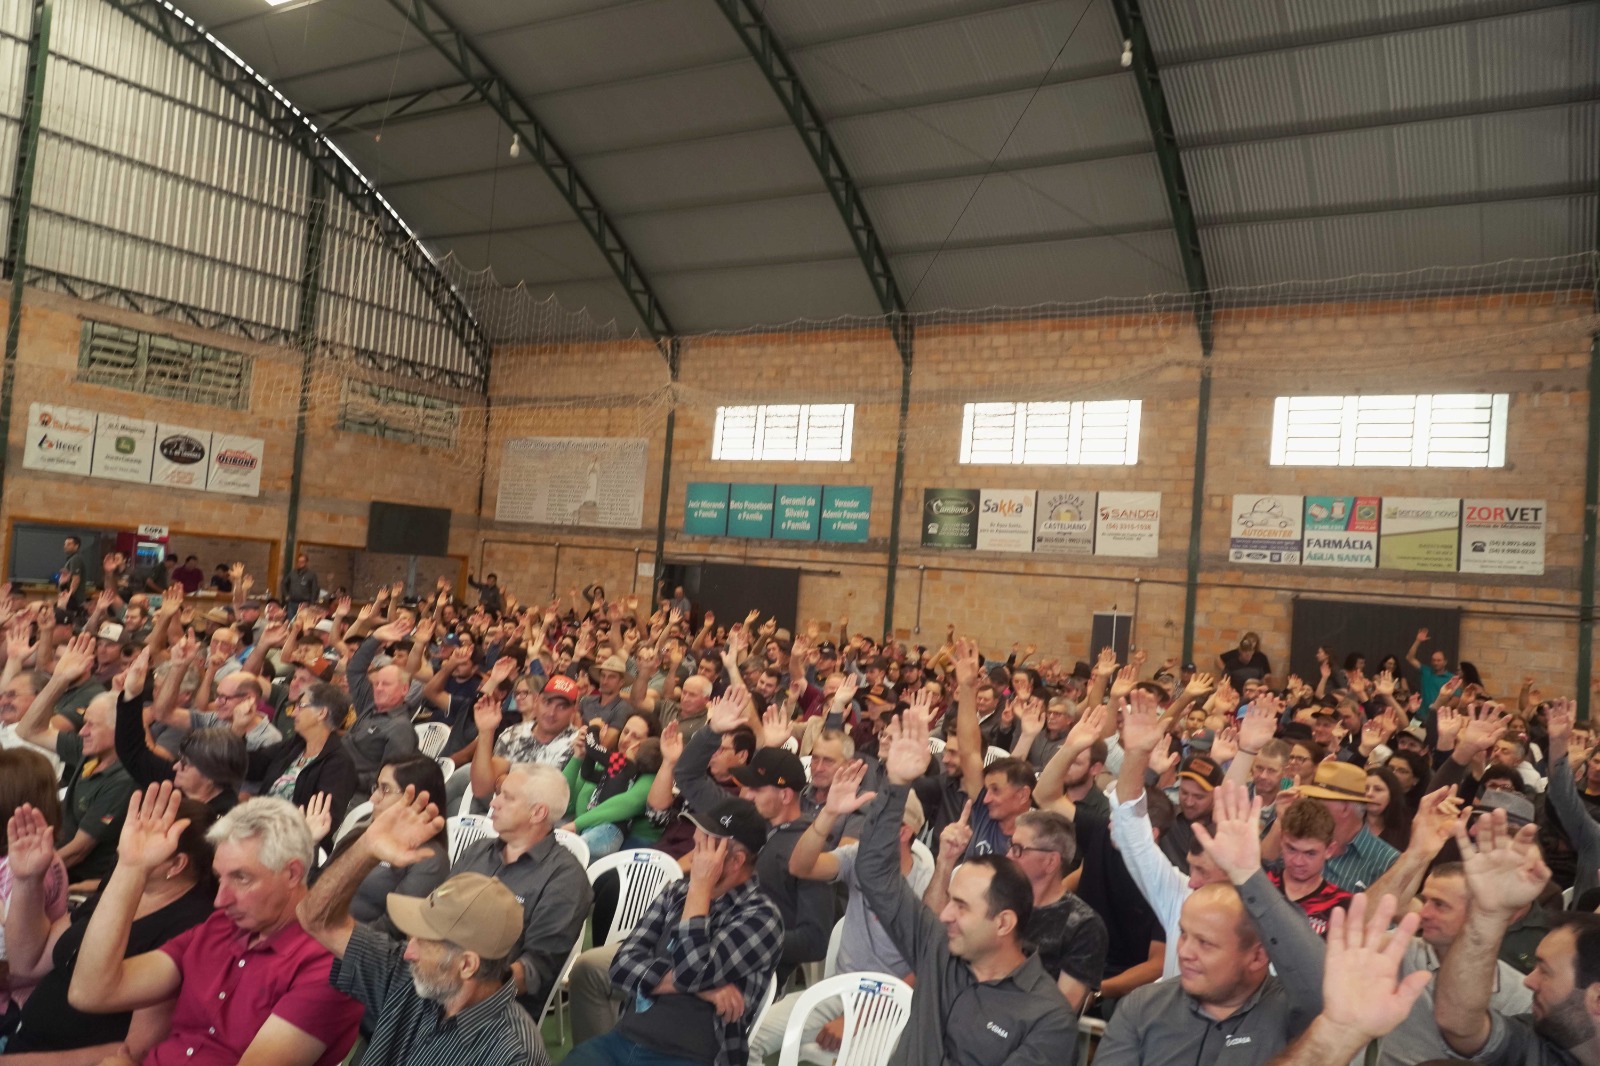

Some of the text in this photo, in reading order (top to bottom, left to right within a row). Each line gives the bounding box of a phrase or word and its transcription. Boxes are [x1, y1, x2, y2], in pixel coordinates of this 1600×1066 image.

[982, 498, 1024, 517] Sakka
[1466, 506, 1543, 521] ZORVET
[1111, 509, 1159, 520] SANDRI
[1241, 528, 1294, 538] AUTOCENTER
[1306, 537, 1373, 550] FARMÁCIA
[1306, 550, 1372, 563] ÁGUA SANTA
